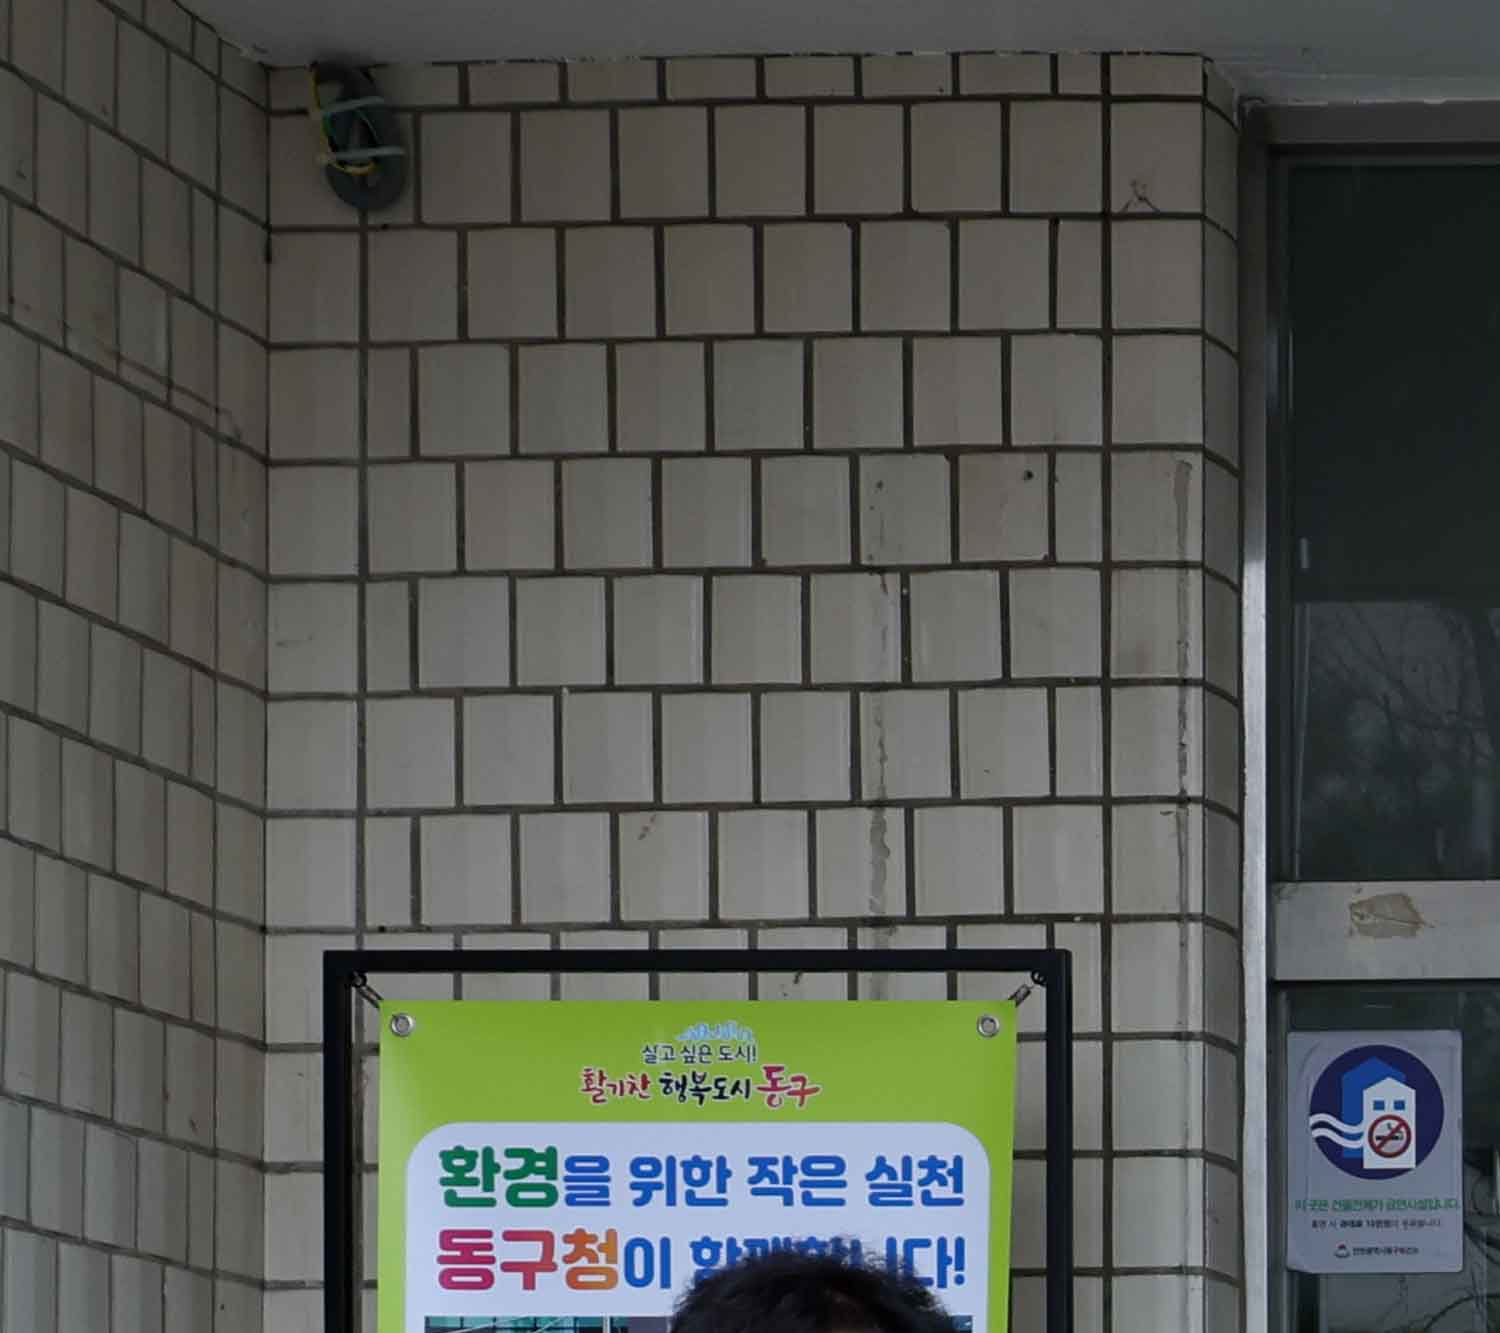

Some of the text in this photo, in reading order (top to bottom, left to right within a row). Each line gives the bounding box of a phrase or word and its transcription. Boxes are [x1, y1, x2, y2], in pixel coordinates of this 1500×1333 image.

[642, 1045, 756, 1064] 살고 싶은 도시!
[581, 1065, 821, 1108] 활기찬 행복도시 동구
[439, 1146, 964, 1209] 환경을 위한 작은 실천
[437, 1228, 671, 1291] 동구청이
